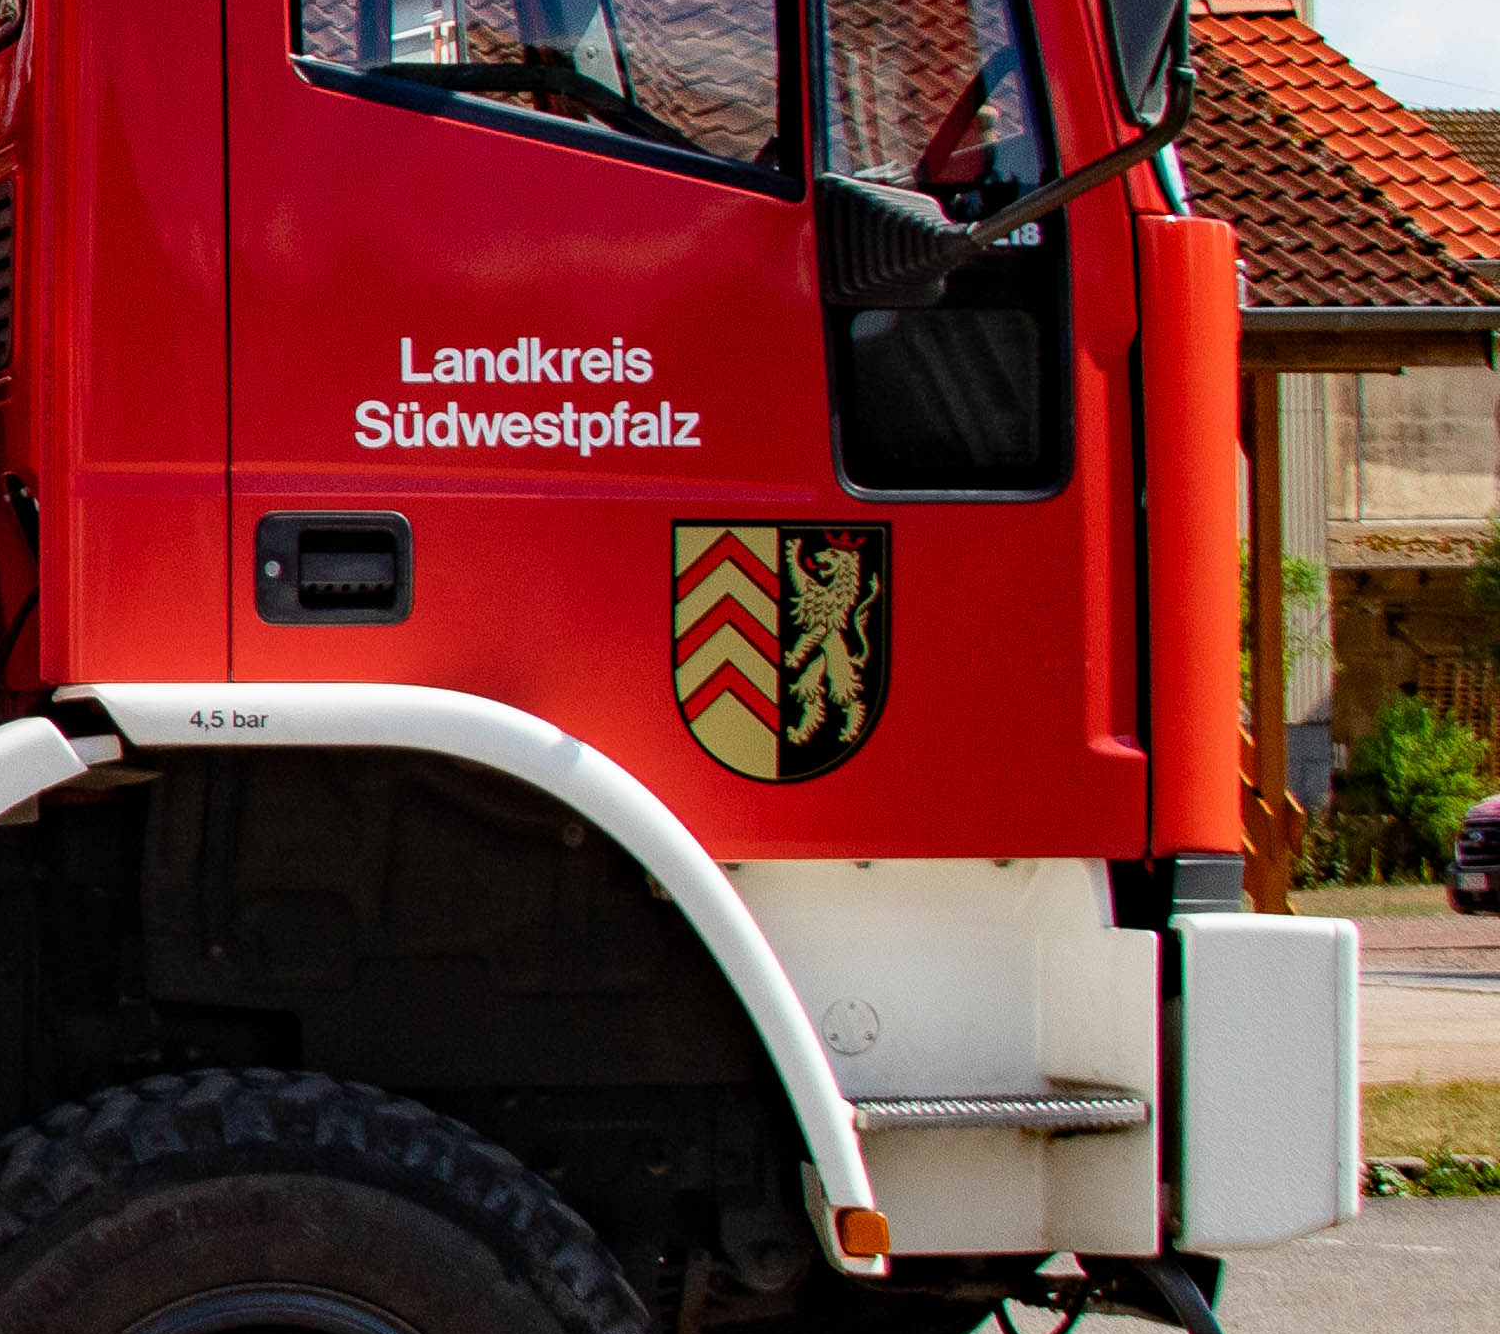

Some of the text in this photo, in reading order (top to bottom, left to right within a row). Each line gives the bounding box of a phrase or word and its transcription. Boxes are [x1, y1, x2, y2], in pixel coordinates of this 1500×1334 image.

[401, 336, 653, 384] Landkreis
[354, 399, 701, 456] Südwestpfalz
[189, 709, 269, 731] 4,5 bar
